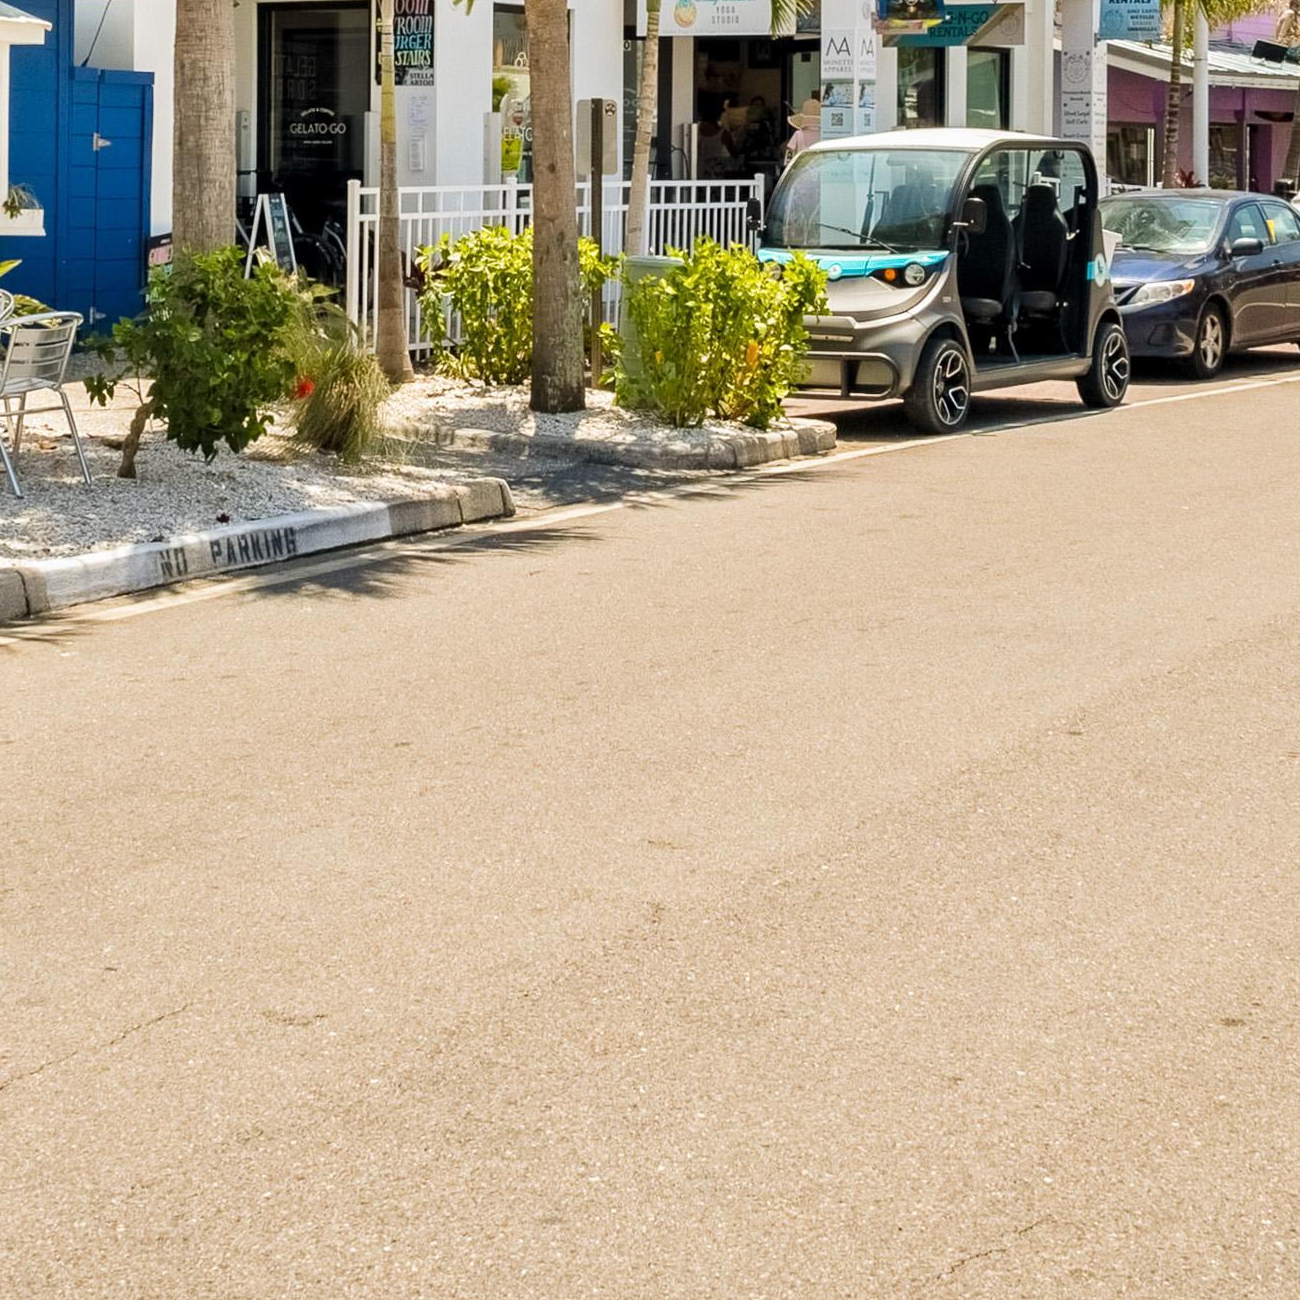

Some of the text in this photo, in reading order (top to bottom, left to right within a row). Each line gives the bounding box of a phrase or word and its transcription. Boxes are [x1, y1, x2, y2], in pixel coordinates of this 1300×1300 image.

[716, 5, 736, 14] YOGA
[945, 9, 989, 25] E-N-GO
[394, 15, 433, 35] ROOM
[711, 16, 740, 25] STUDIO
[929, 25, 977, 38] RENTALS
[395, 33, 432, 50] URGER
[159, 527, 298, 577] NO PARKING
